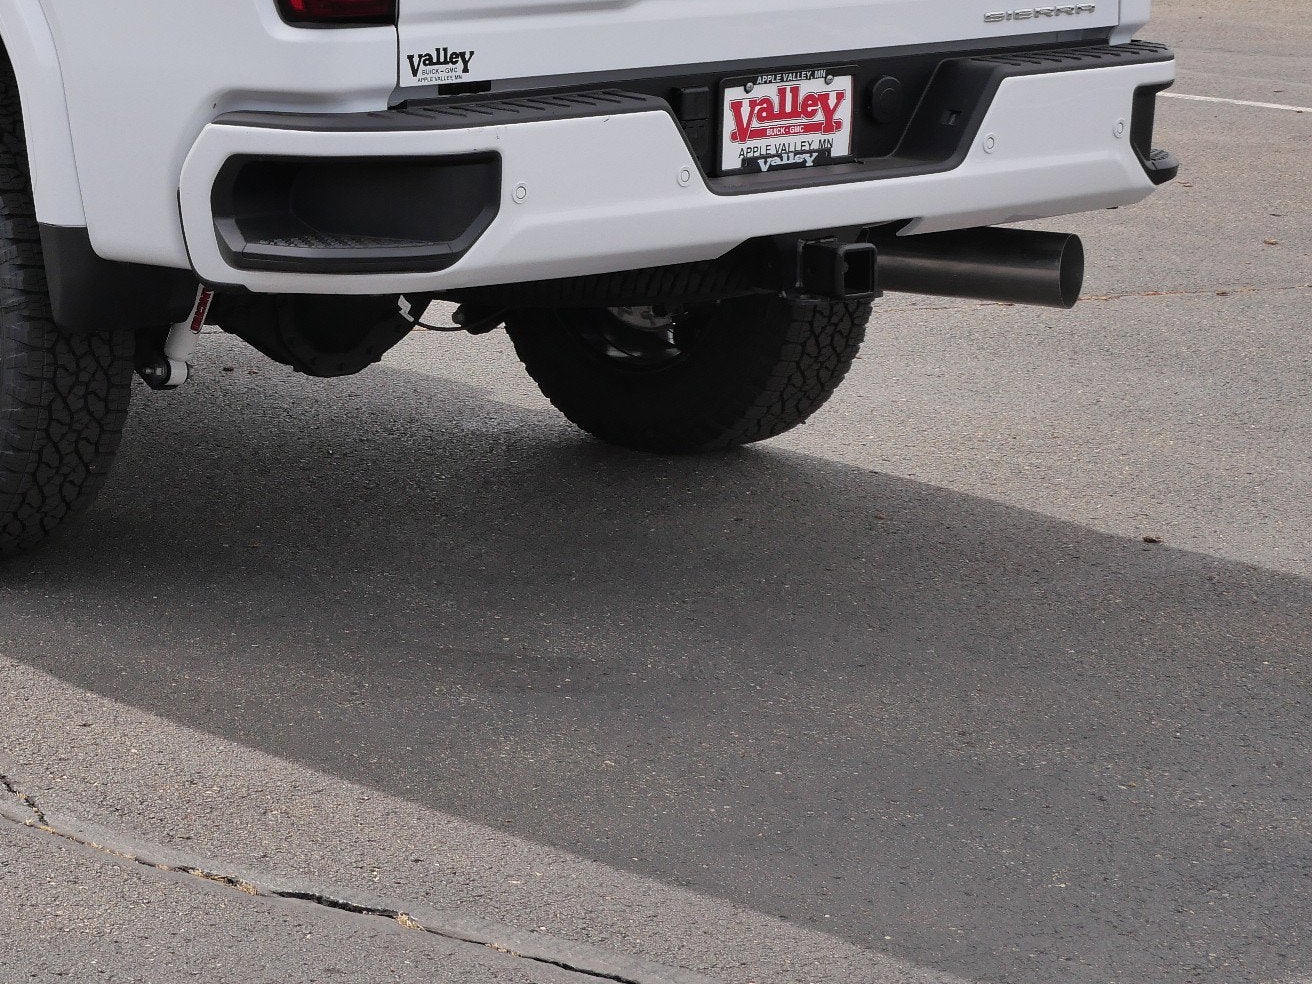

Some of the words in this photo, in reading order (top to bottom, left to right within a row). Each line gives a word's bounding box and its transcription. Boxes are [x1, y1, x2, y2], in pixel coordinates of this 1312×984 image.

[984, 3, 1096, 22] SIERRA
[407, 47, 475, 77] Valley
[756, 74, 781, 84] APPLE
[814, 70, 826, 78] MN
[730, 85, 846, 143] Valley
[767, 127, 785, 135] BUICK
[789, 125, 805, 133] GMC
[738, 145, 772, 158] APPLE
[818, 138, 834, 149] MN
[757, 153, 818, 171] Valley
